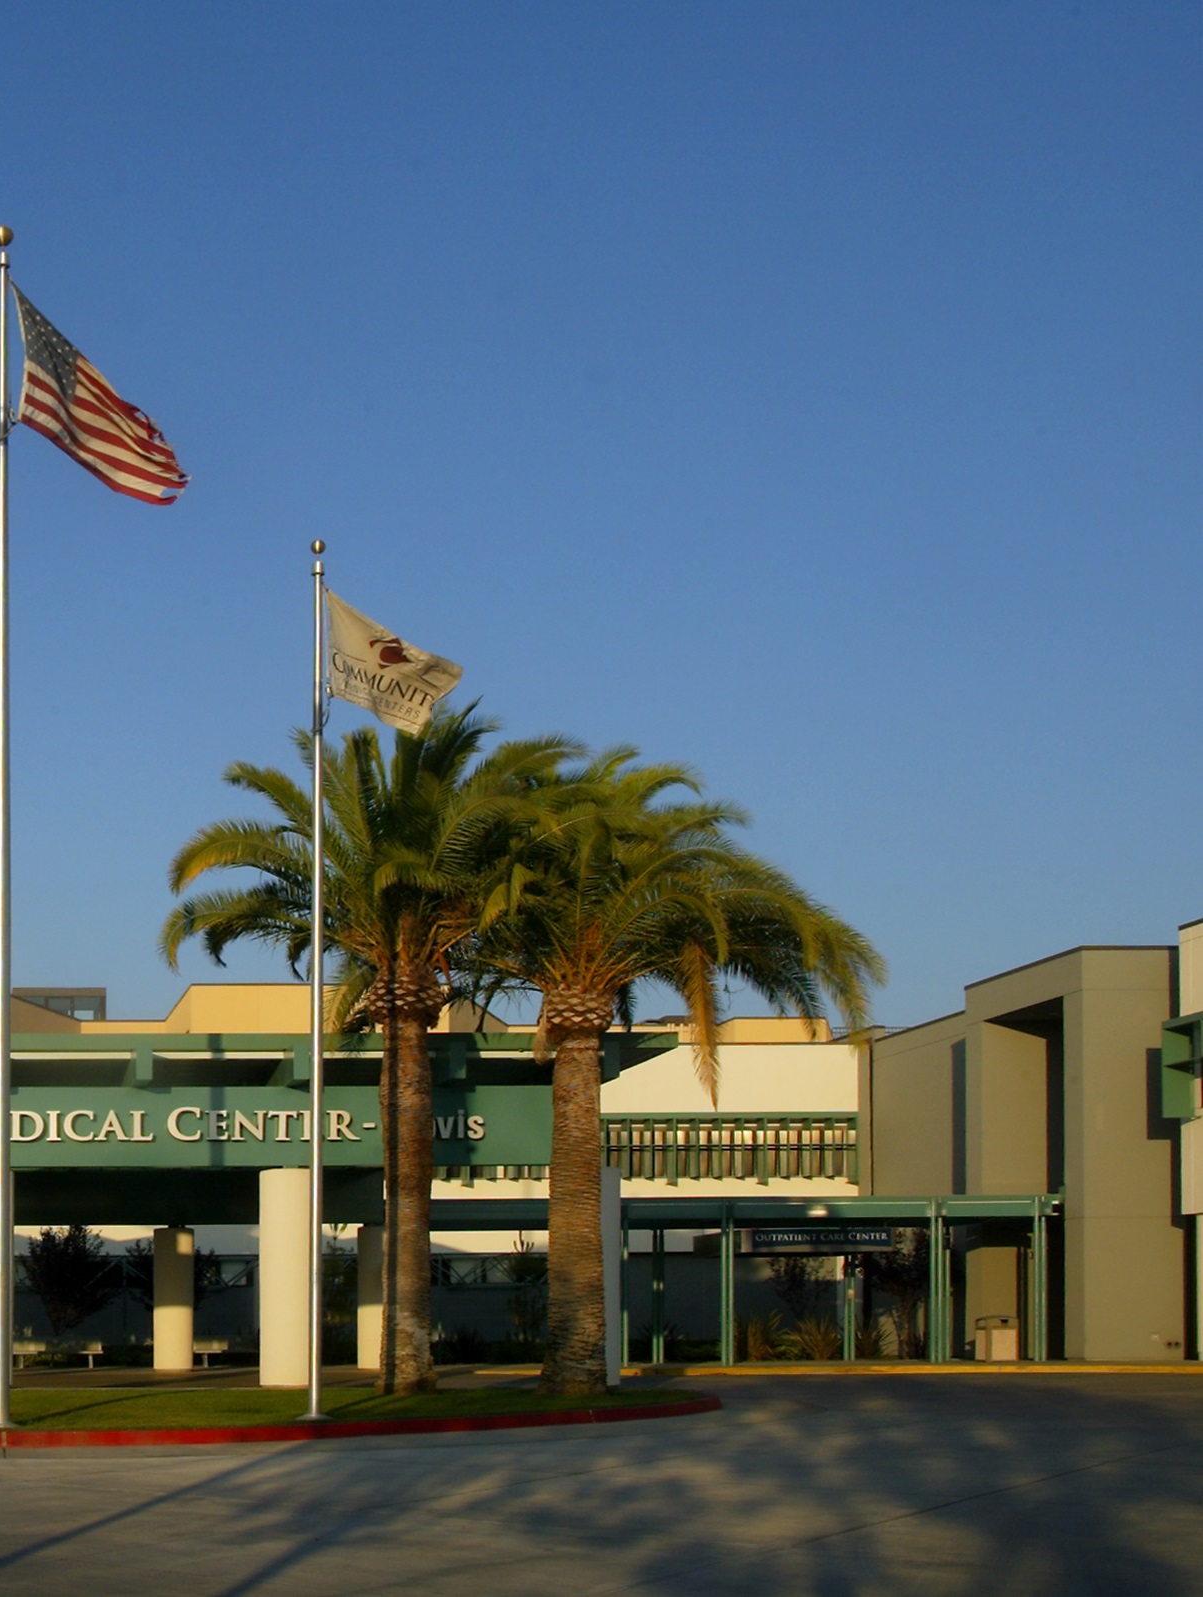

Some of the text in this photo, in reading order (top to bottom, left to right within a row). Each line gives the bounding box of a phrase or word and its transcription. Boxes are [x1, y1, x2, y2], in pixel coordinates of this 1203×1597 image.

[332, 652, 434, 706] CMMUNIT
[430, 1110, 486, 1140] vis
[848, 1231, 889, 1241] CENTER
